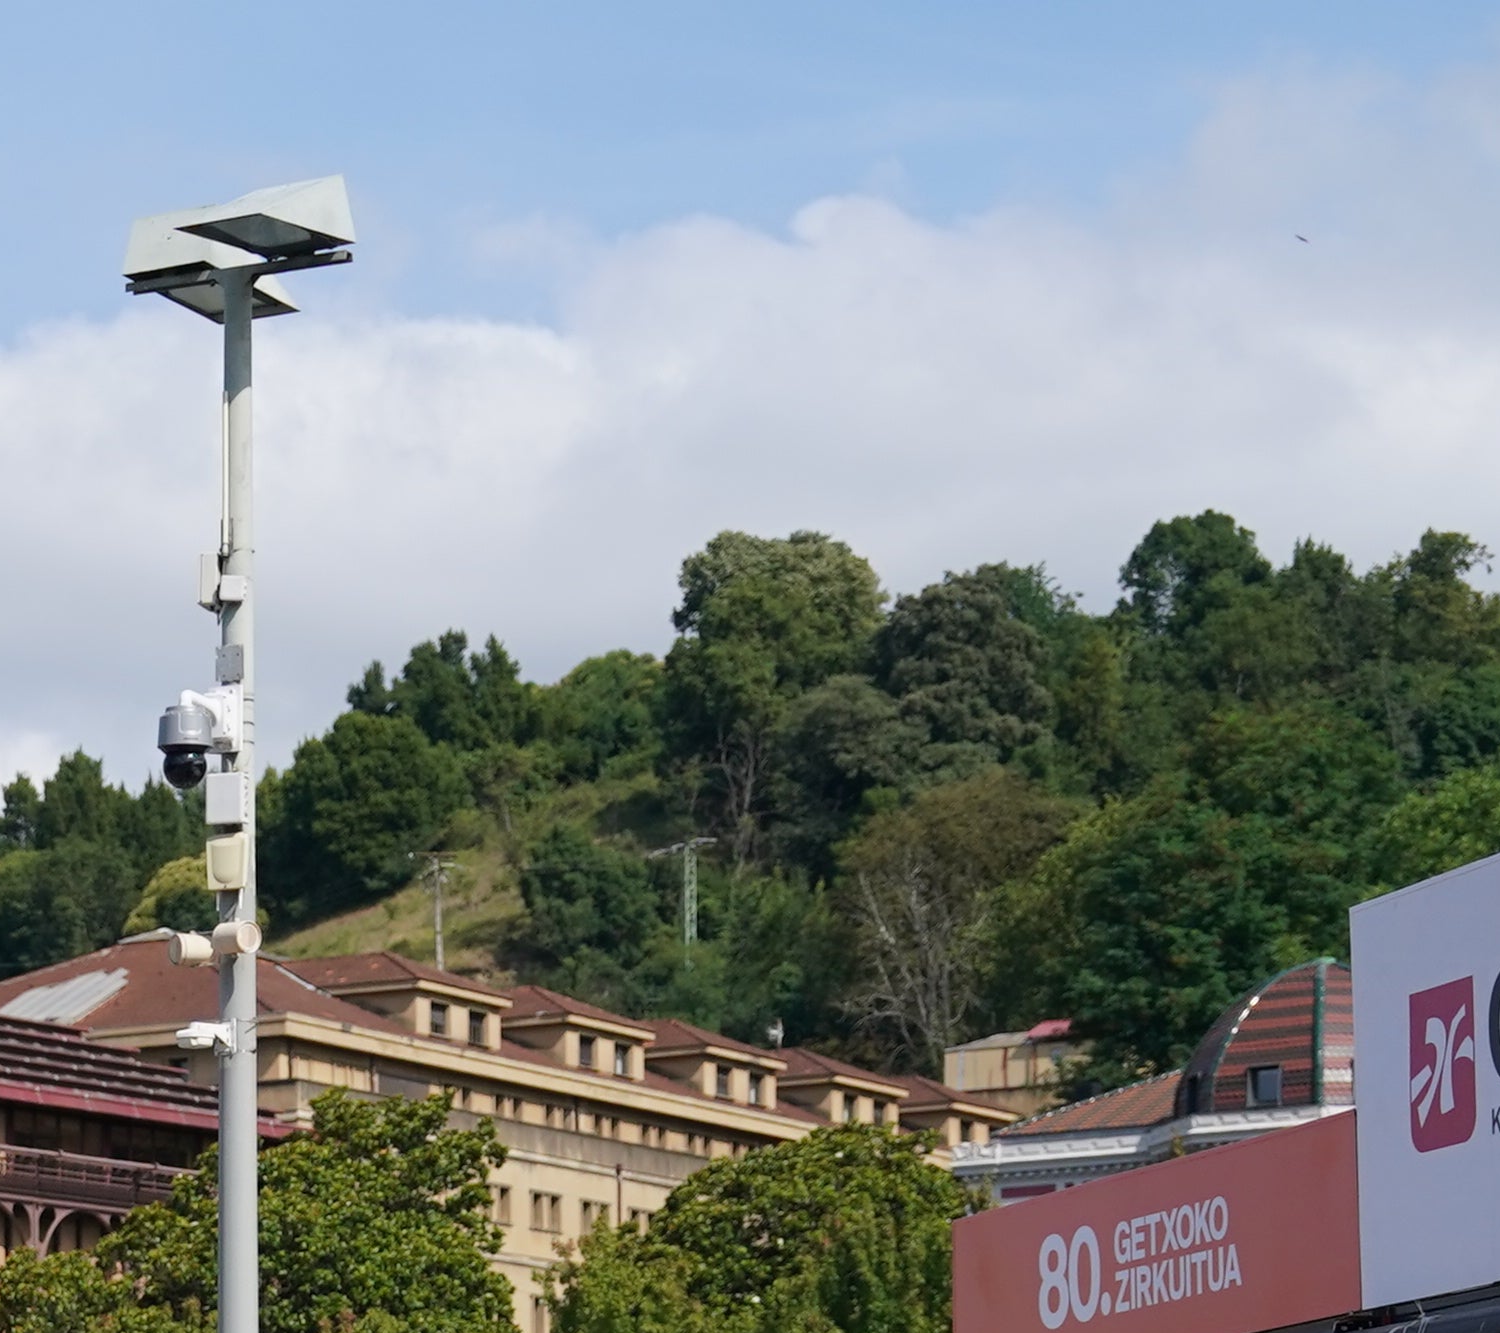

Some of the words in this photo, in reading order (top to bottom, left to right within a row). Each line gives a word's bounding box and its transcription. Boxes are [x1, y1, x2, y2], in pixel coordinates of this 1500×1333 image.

[1113, 1196, 1229, 1265] GETXOKO
[1037, 1224, 1111, 1332] 80.
[1114, 1244, 1242, 1313] ZIRKUITUA
